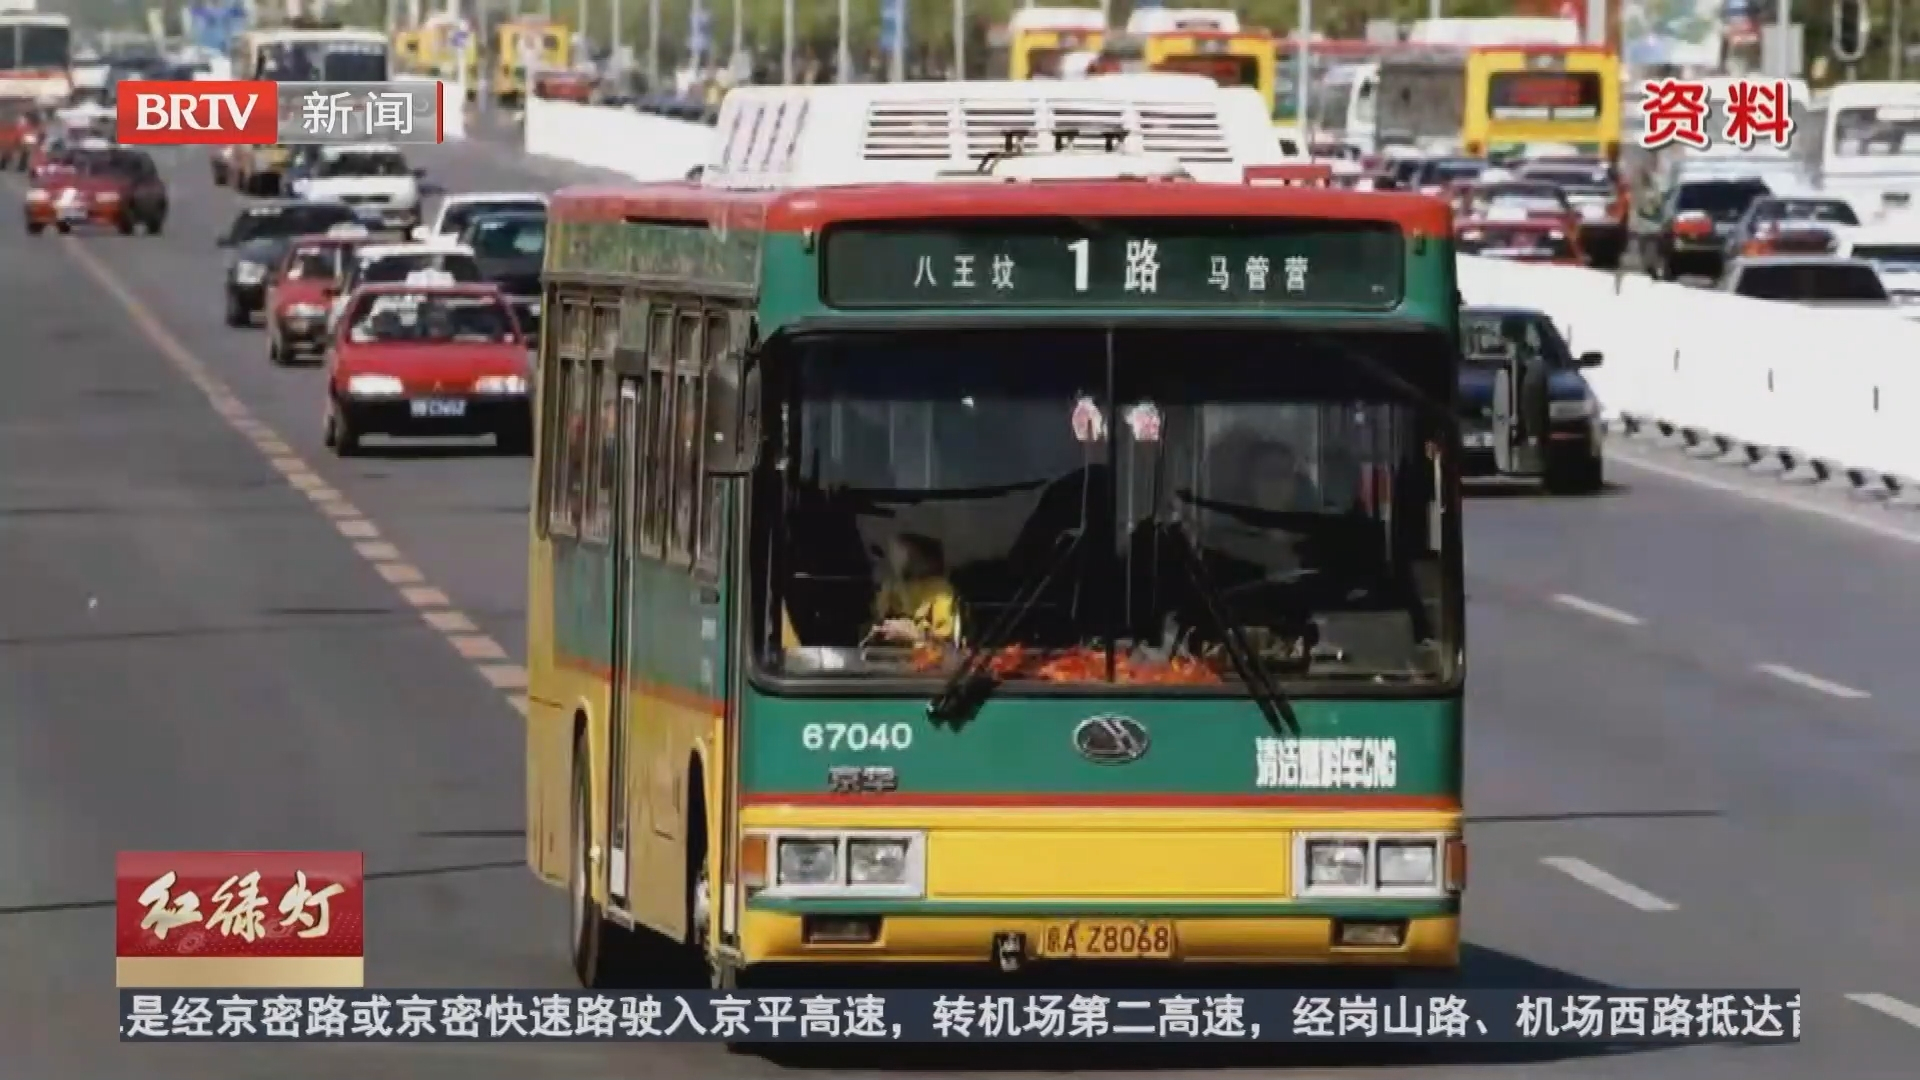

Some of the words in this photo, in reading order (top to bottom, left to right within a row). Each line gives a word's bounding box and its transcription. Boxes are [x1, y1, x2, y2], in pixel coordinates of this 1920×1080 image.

[913, 255, 1015, 290] 八王坟
[1207, 255, 1309, 291] 马管营
[802, 722, 913, 751] 67040
